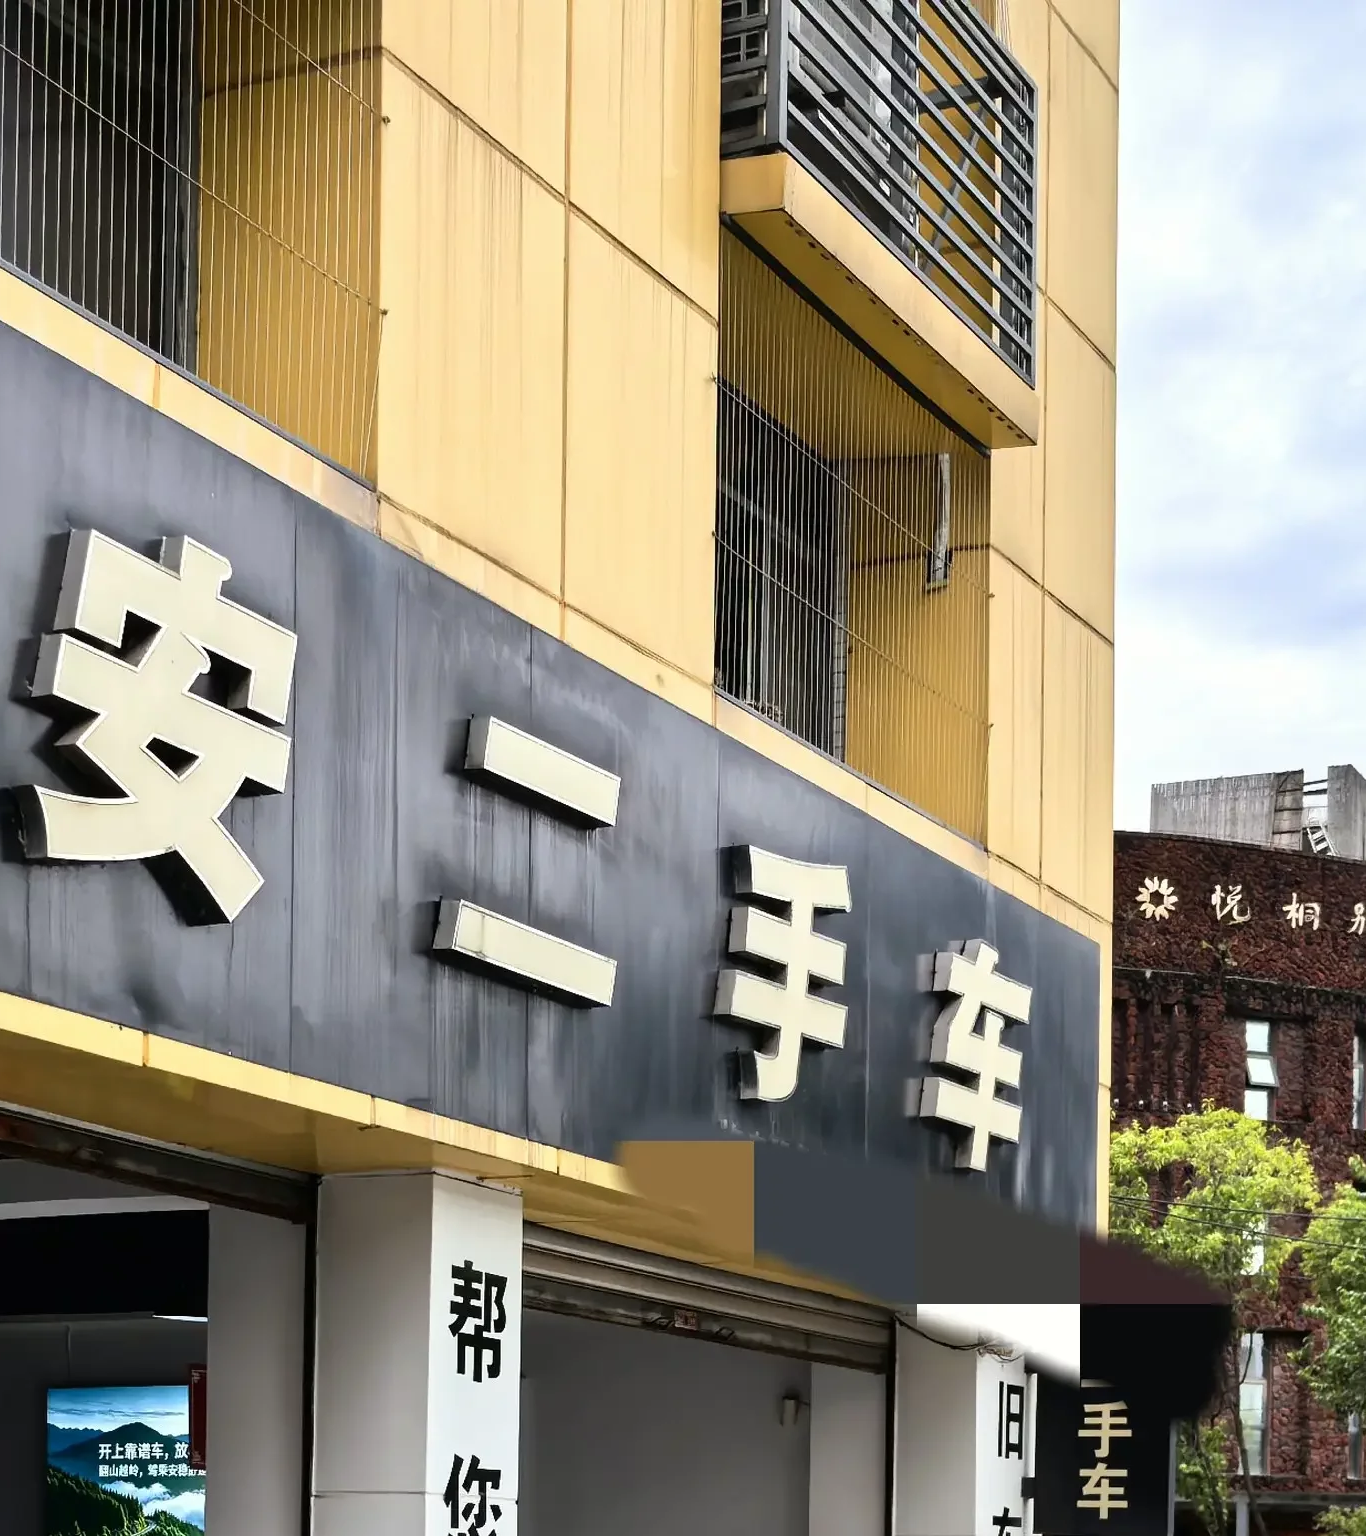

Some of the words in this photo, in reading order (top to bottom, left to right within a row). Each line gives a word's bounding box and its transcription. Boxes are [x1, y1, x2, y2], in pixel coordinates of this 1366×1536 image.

[98, 1441, 191, 1461] 开上靠谱车，放
